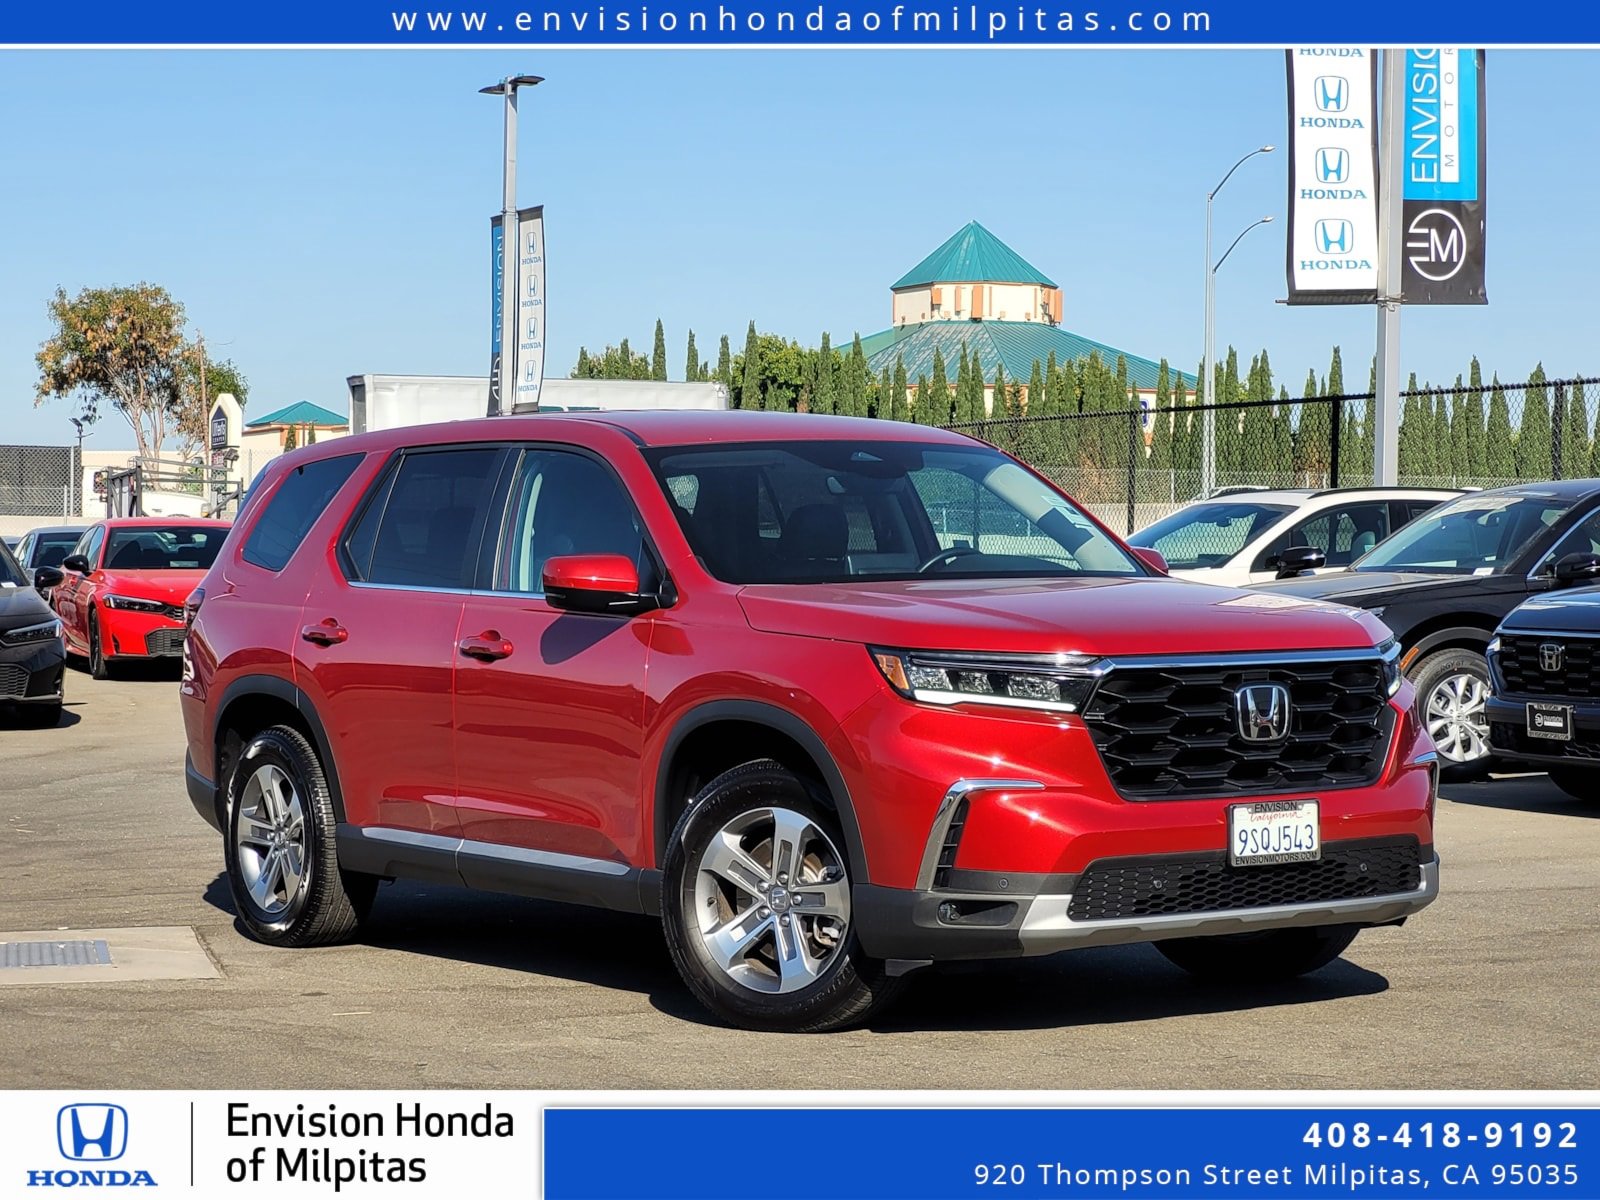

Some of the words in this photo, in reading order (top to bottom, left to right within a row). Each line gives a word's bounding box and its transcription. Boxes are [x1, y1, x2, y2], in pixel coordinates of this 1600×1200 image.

[1300, 117, 1365, 129] HONDA
[1300, 188, 1367, 200] HONDA
[521, 256, 542, 265] HONDA
[1300, 259, 1372, 271] HONDA
[521, 299, 543, 307] HONDA
[520, 341, 542, 350] HONDA
[517, 384, 538, 393] HONDA
[1254, 801, 1298, 814] ENVISION
[1238, 823, 1315, 856] 9SQJ543
[1234, 851, 1318, 866] ENVISIONMOTORS.COM
